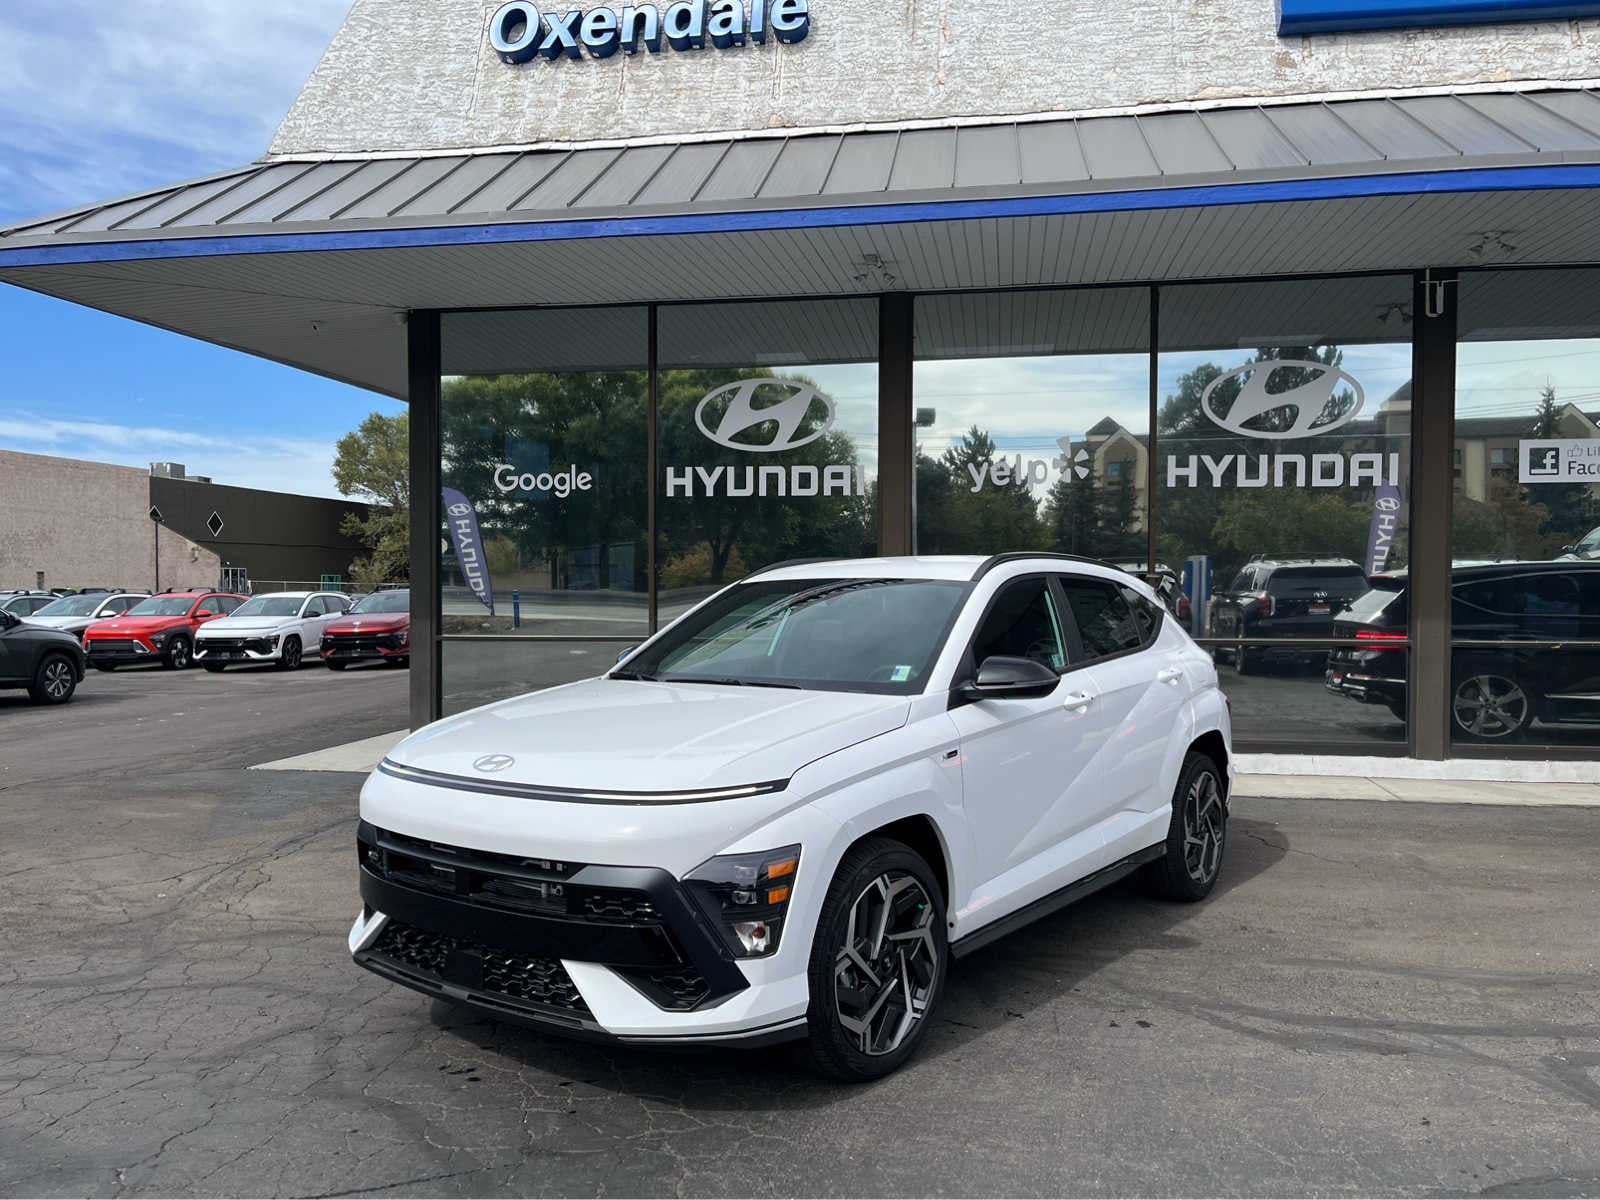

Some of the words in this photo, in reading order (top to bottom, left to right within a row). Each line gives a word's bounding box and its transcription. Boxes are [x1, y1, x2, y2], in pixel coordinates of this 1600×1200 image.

[488, 0, 809, 61] Oxendale
[494, 464, 592, 498] Google
[665, 464, 865, 497] HYUNDAI
[967, 453, 1048, 493] yelp
[1166, 452, 1399, 488] HYUNDAI
